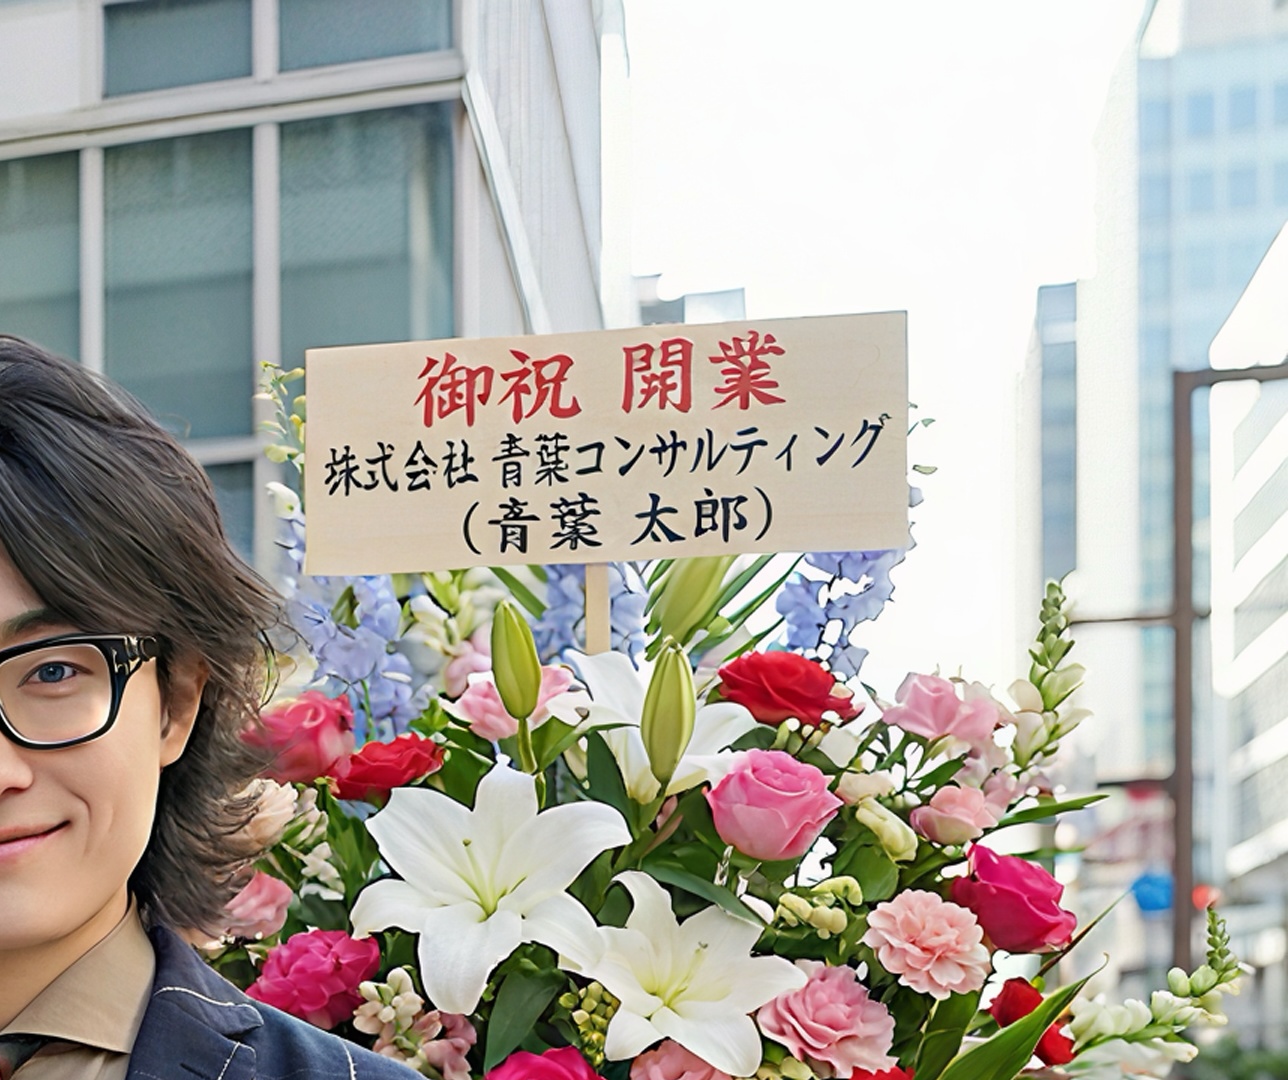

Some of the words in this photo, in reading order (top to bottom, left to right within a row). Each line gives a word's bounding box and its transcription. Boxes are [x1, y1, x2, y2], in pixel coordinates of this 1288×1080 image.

[416, 349, 581, 428] 御祝
[621, 330, 786, 414] 開業
[324, 438, 480, 497] 株式会社
[491, 413, 893, 489] 青葉コンサルティング
